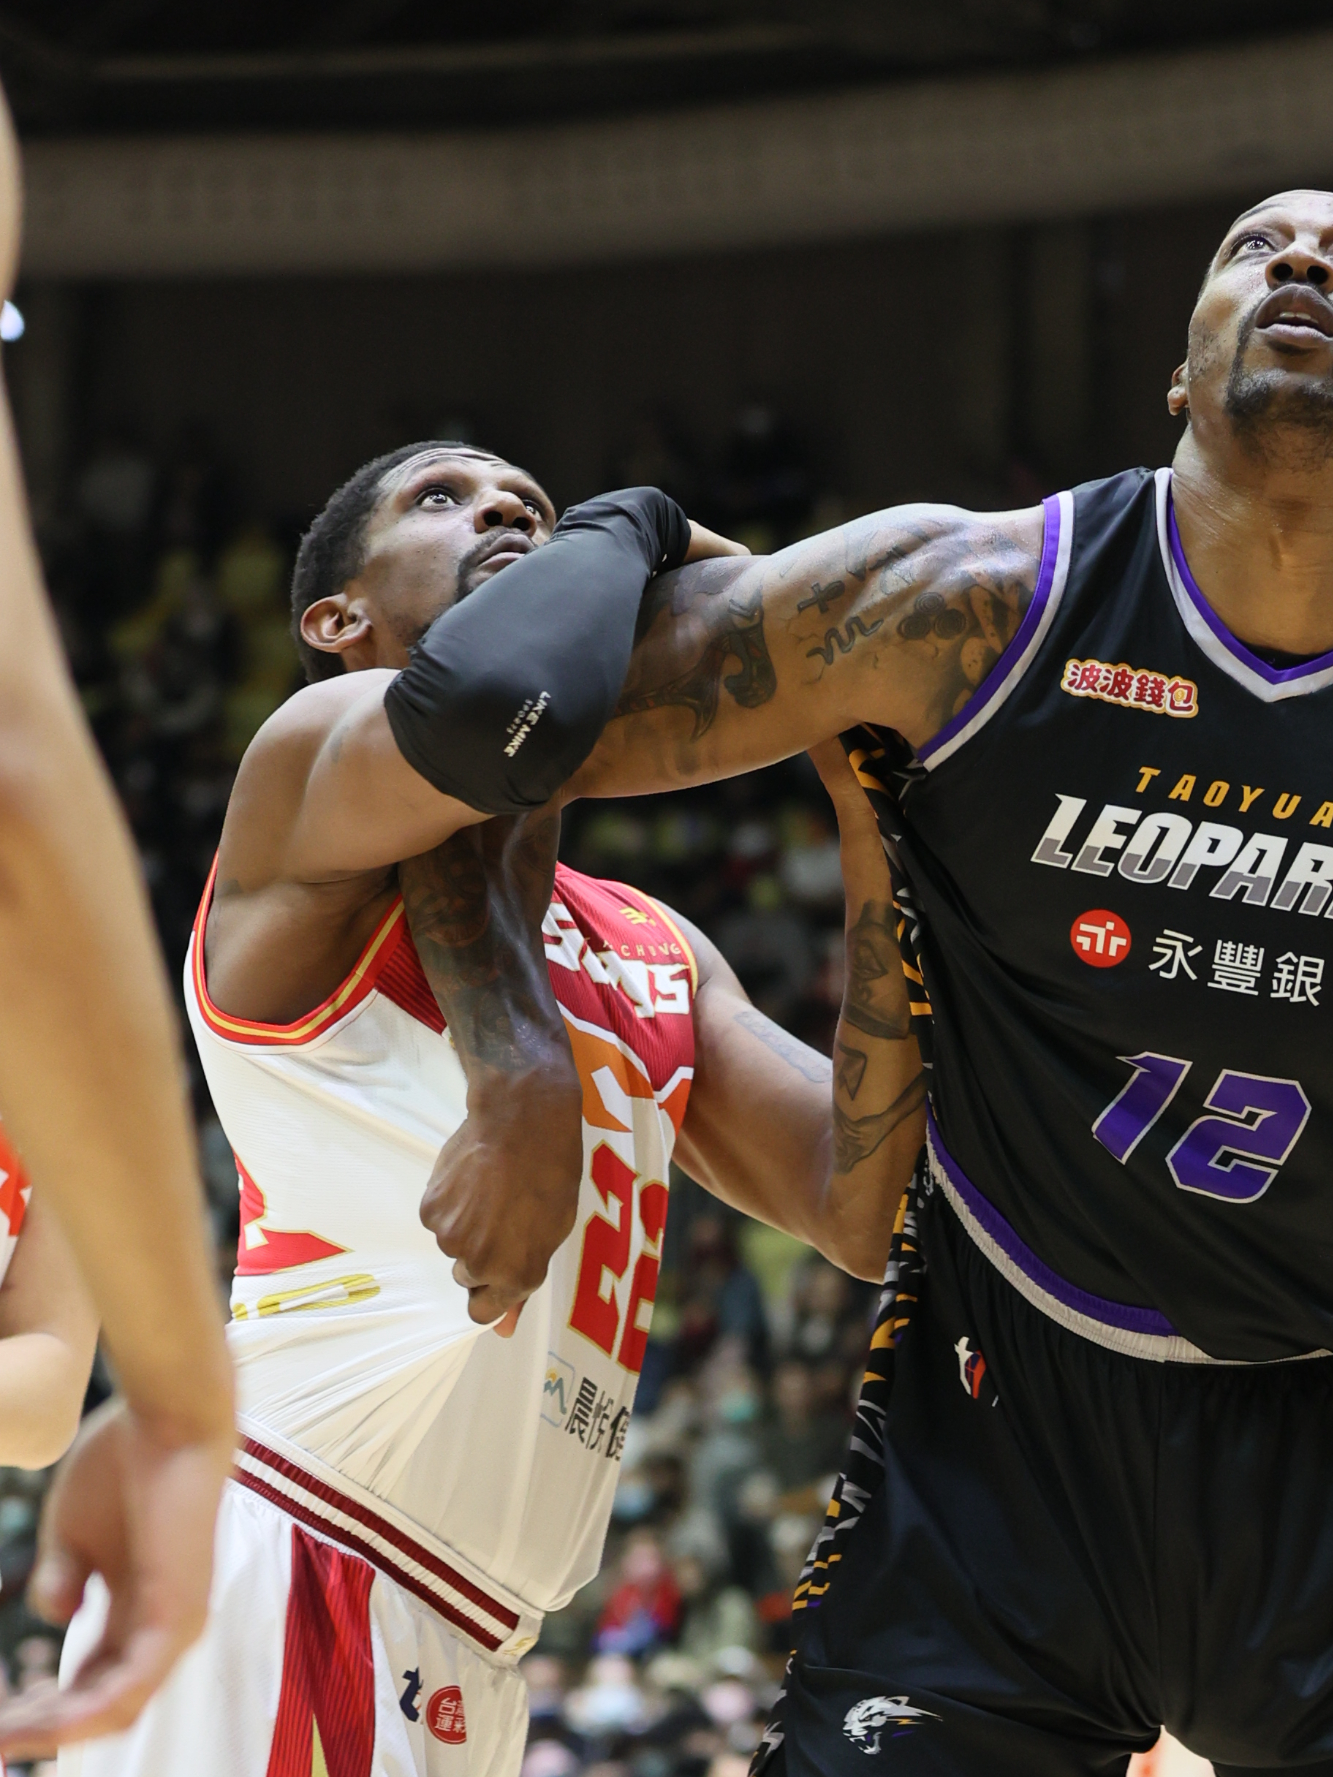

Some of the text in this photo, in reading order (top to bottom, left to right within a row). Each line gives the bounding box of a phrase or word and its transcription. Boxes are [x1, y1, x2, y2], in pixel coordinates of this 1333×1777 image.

[1064, 662, 1196, 714] 波波錢包
[503, 690, 552, 758] LIKE MIKE
[1091, 1051, 1313, 1204] 12
